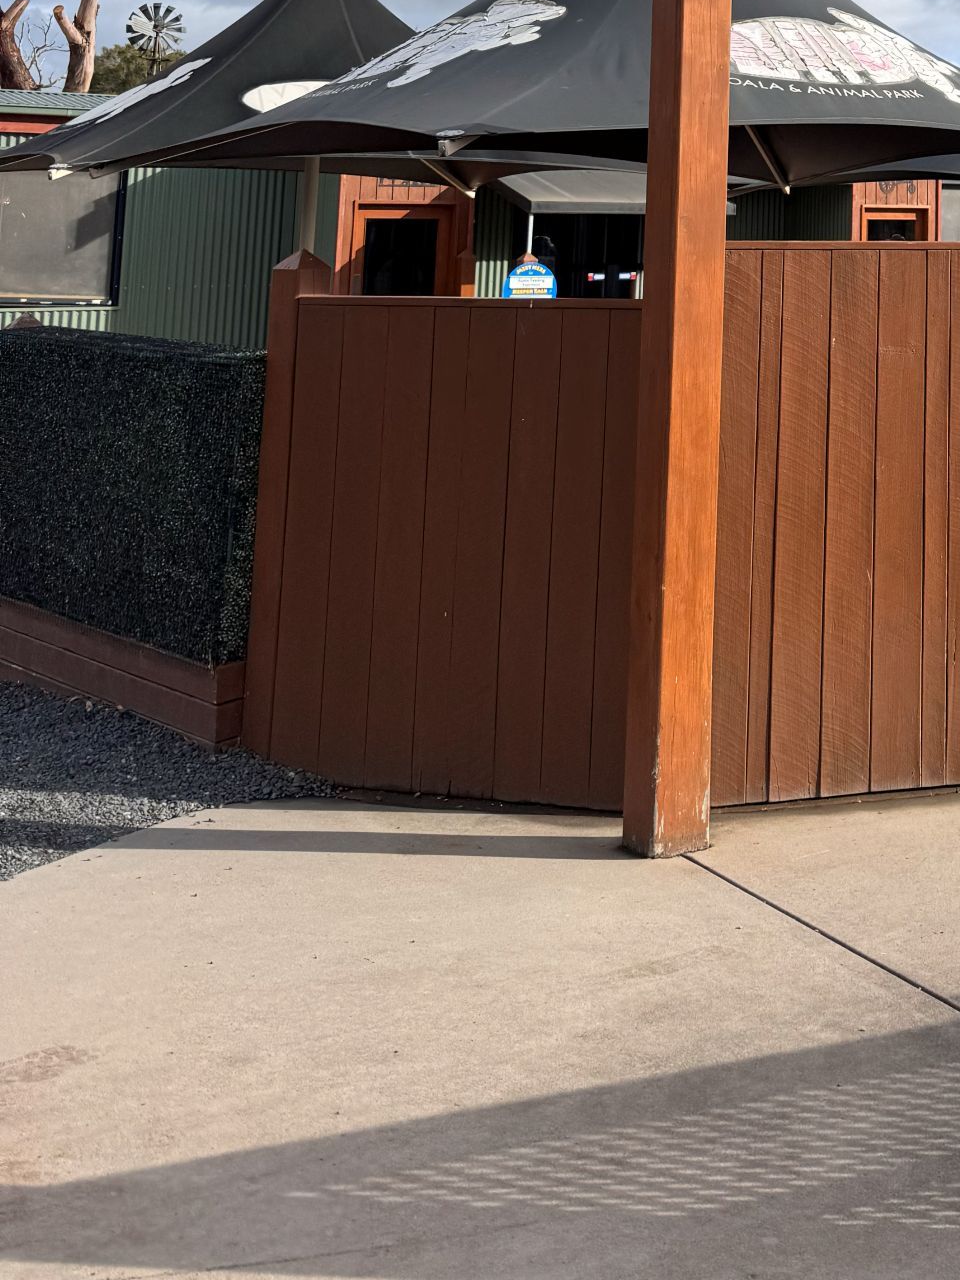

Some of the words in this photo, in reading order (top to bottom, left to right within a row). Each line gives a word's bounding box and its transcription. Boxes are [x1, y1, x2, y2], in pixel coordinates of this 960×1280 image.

[729, 77, 784, 91] OALA
[789, 84, 802, 93] &
[807, 86, 883, 99] ANIMAL
[883, 90, 924, 99] PARK
